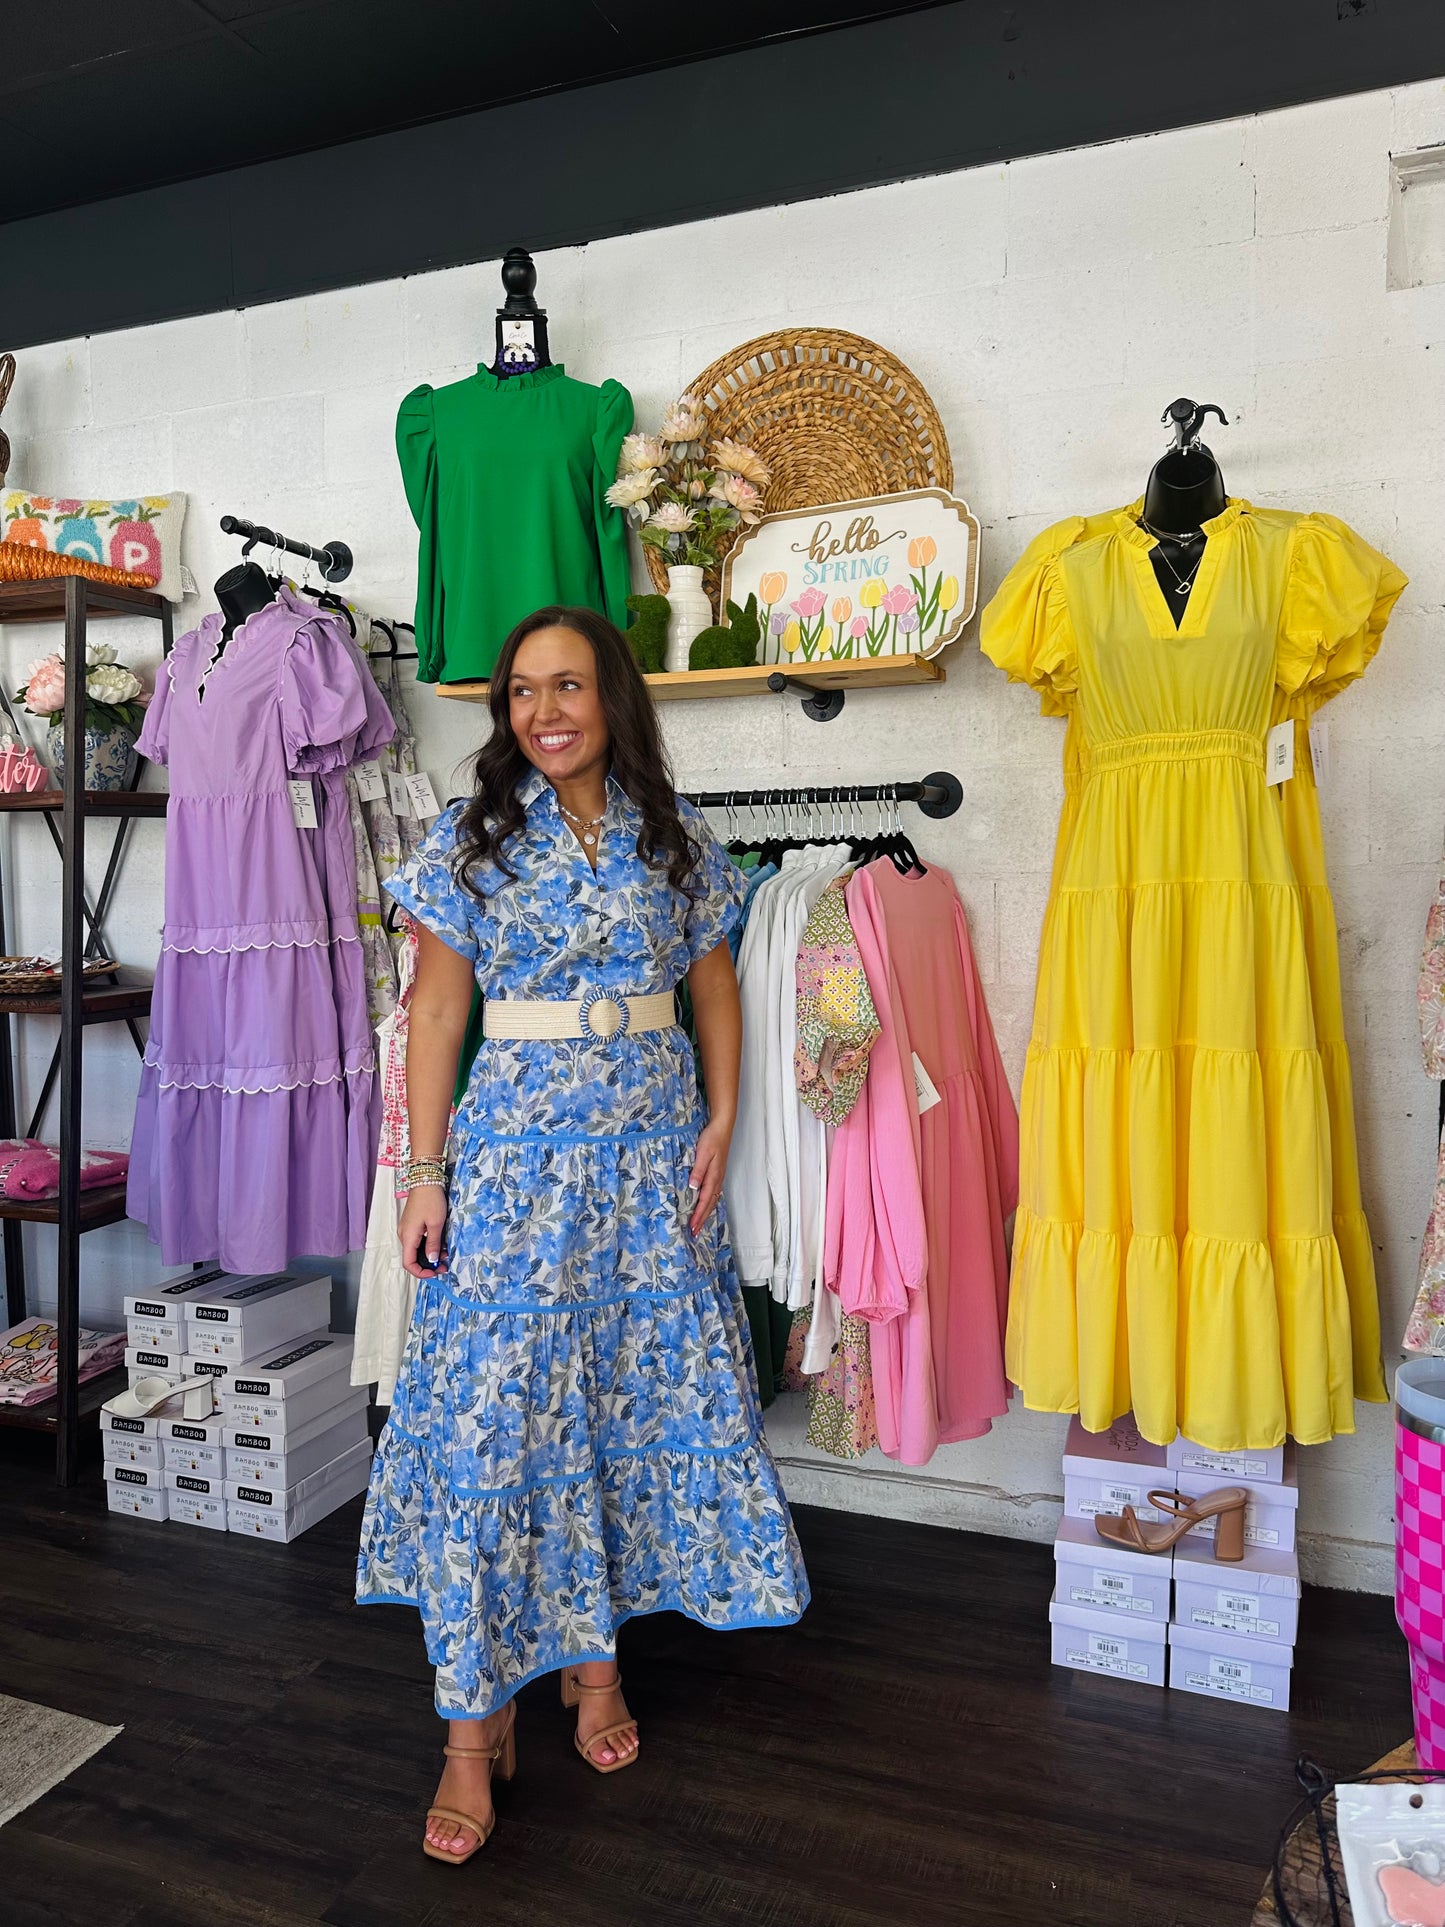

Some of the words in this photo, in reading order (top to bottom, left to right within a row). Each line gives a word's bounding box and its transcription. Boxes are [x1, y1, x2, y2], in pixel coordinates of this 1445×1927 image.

[791, 516, 907, 564] hello
[803, 556, 890, 584] SPRING
[136, 1304, 164, 1315] BAMBOO
[198, 1310, 226, 1319] BAMBOO
[138, 1355, 166, 1365] BAMBOO
[196, 1366, 226, 1375] BAMBOO
[237, 1384, 268, 1392] BAMBOO
[113, 1421, 142, 1431] BAMBOO
[174, 1428, 204, 1439] BAMBOO
[237, 1437, 268, 1447] BAMBOO
[117, 1472, 145, 1482] BAMBOO
[179, 1480, 208, 1490] BAMBOO
[240, 1490, 270, 1502] BAMBOO
